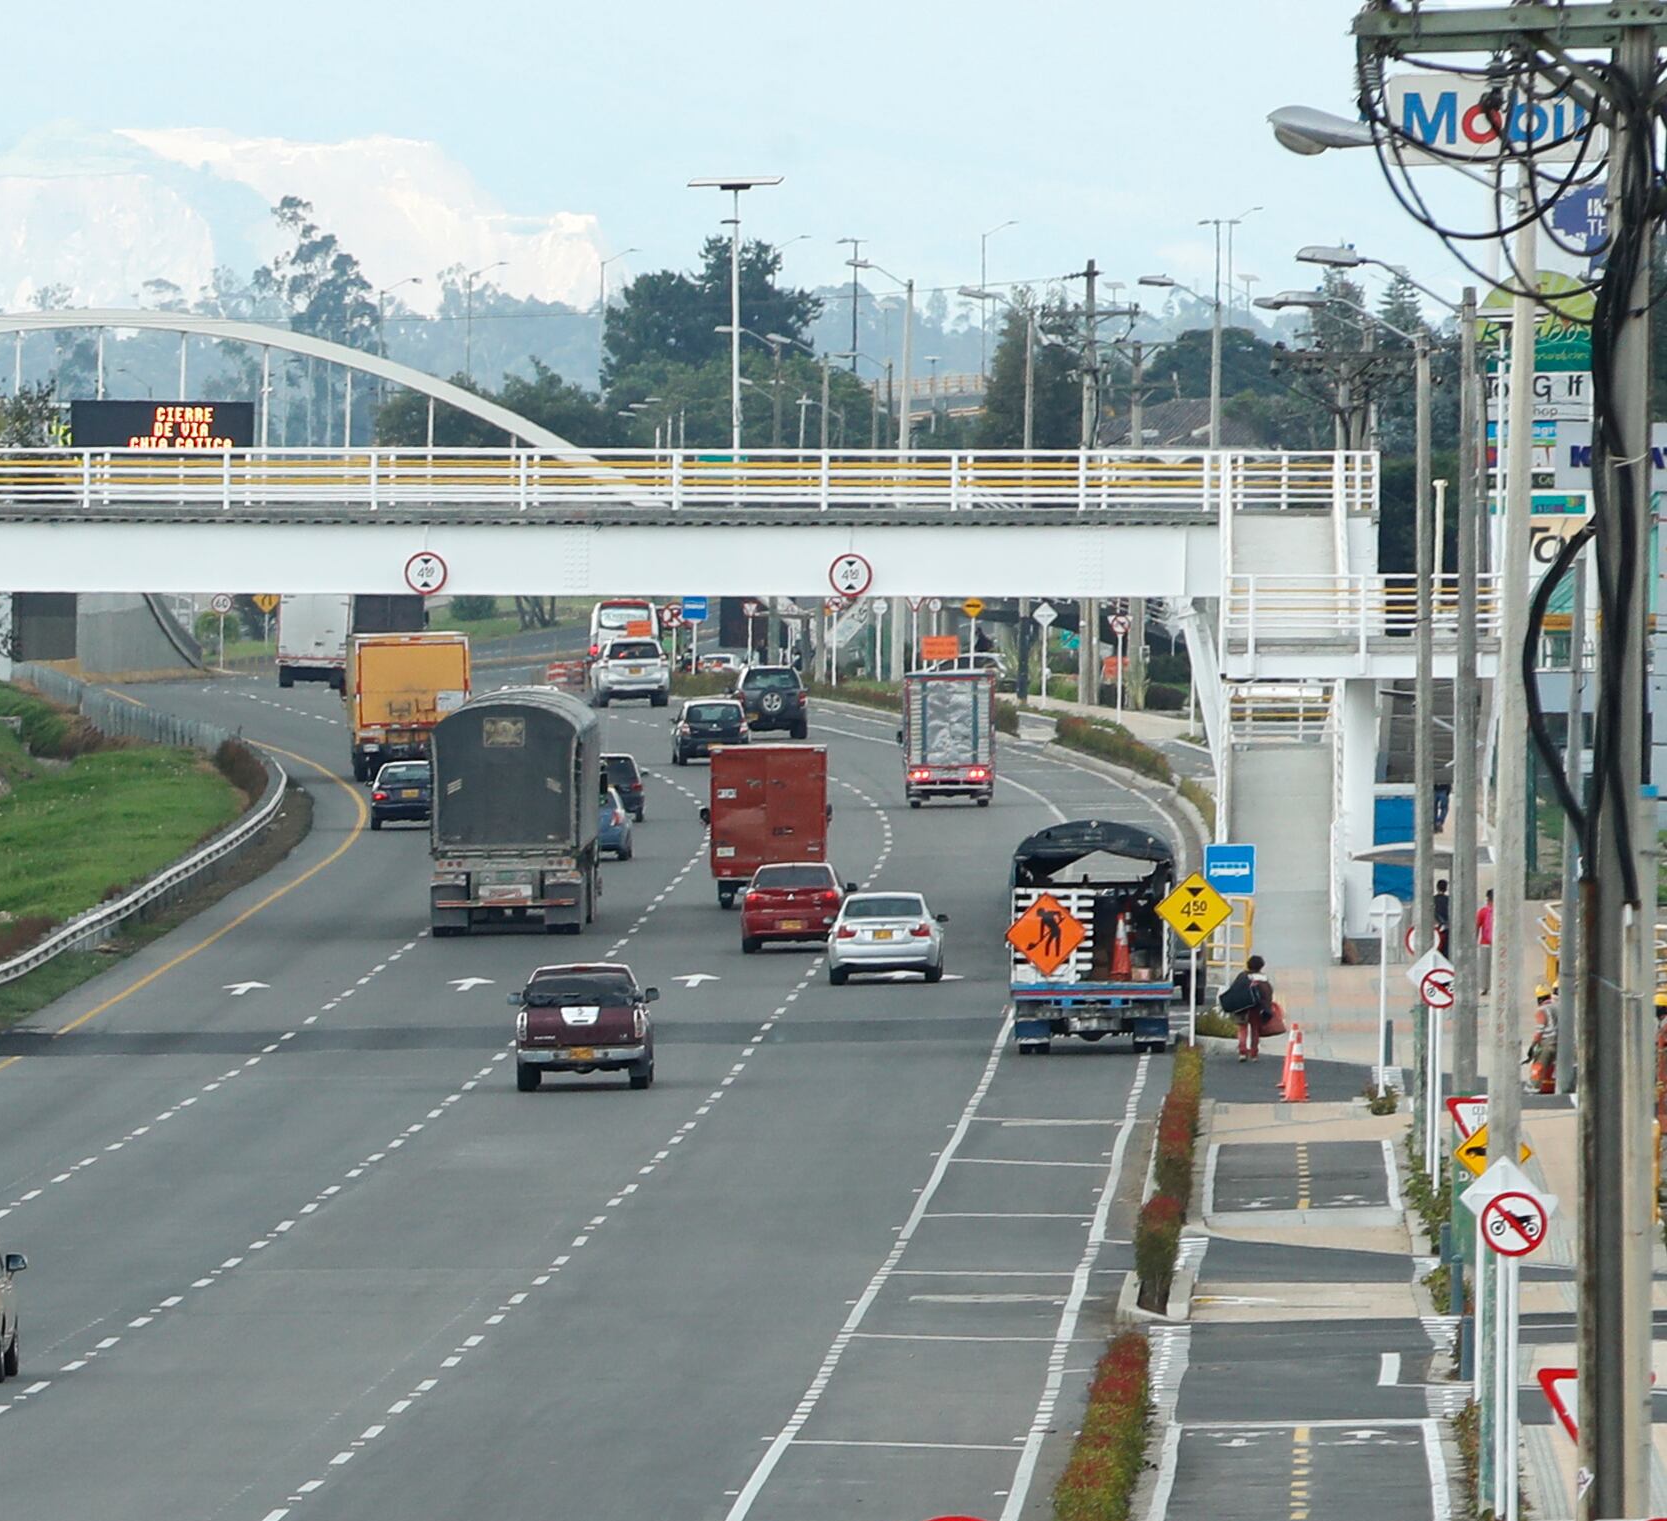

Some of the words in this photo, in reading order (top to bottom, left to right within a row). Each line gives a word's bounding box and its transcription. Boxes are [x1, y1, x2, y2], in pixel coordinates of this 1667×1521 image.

[155, 406, 214, 422] CIERRE
[153, 422, 174, 438] DE
[180, 422, 209, 438] VIA
